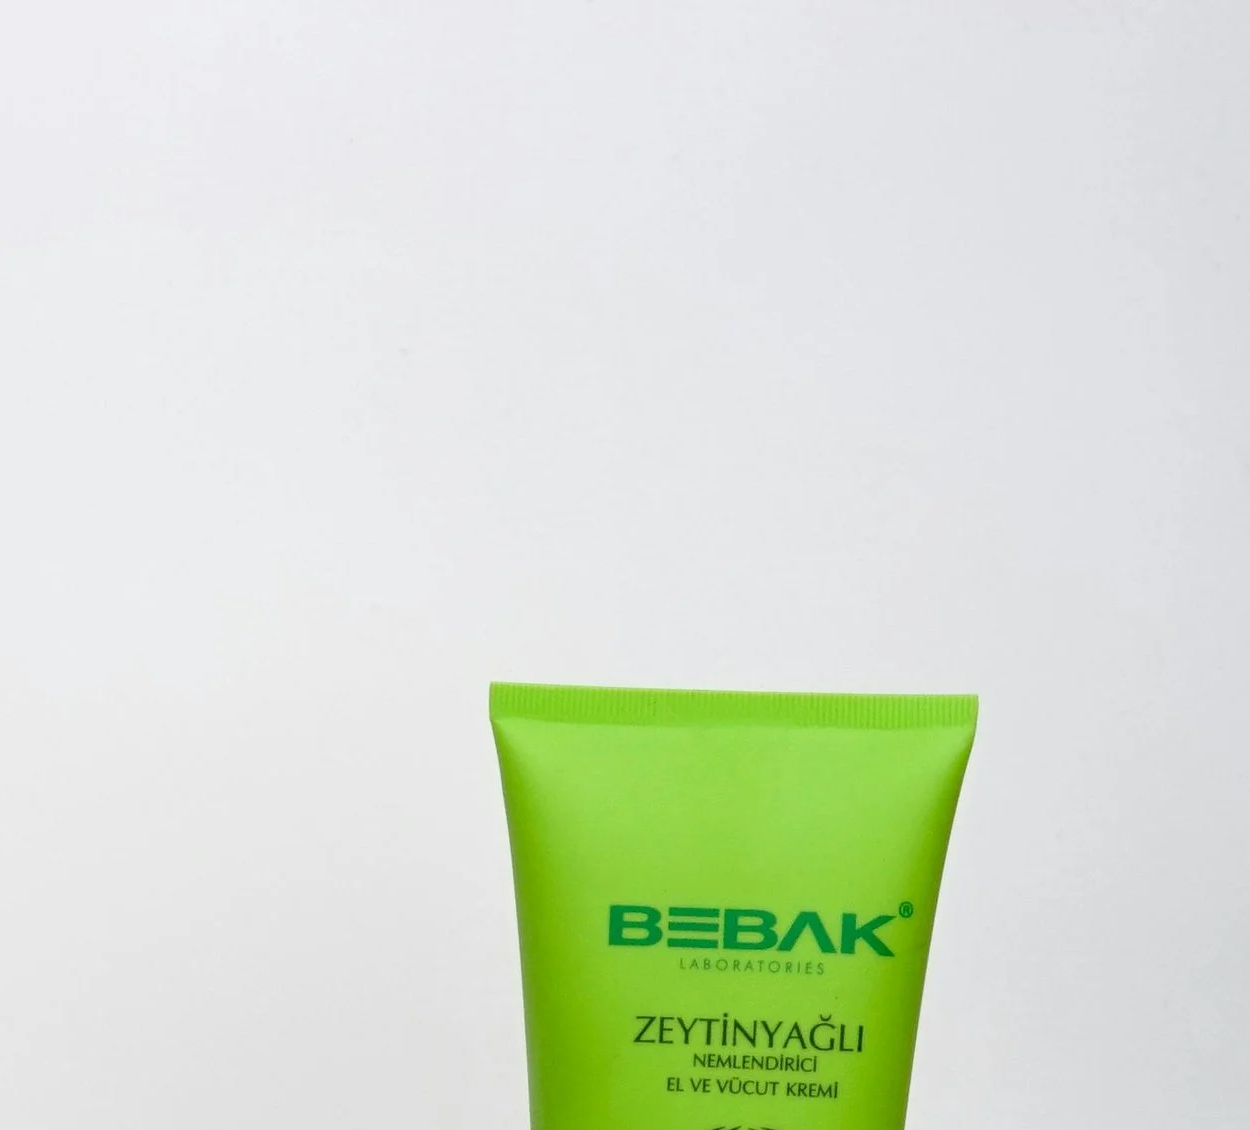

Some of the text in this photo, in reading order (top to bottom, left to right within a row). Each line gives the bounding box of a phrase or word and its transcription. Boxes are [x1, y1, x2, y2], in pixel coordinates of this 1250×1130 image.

[679, 958, 825, 975] LABORATORIES
[634, 1012, 864, 1052] ZEYTİNYAĞLI
[693, 1053, 818, 1073] NEMLENDİRİCİ
[666, 1077, 838, 1099] EL VE VÜCUT KREMİ
